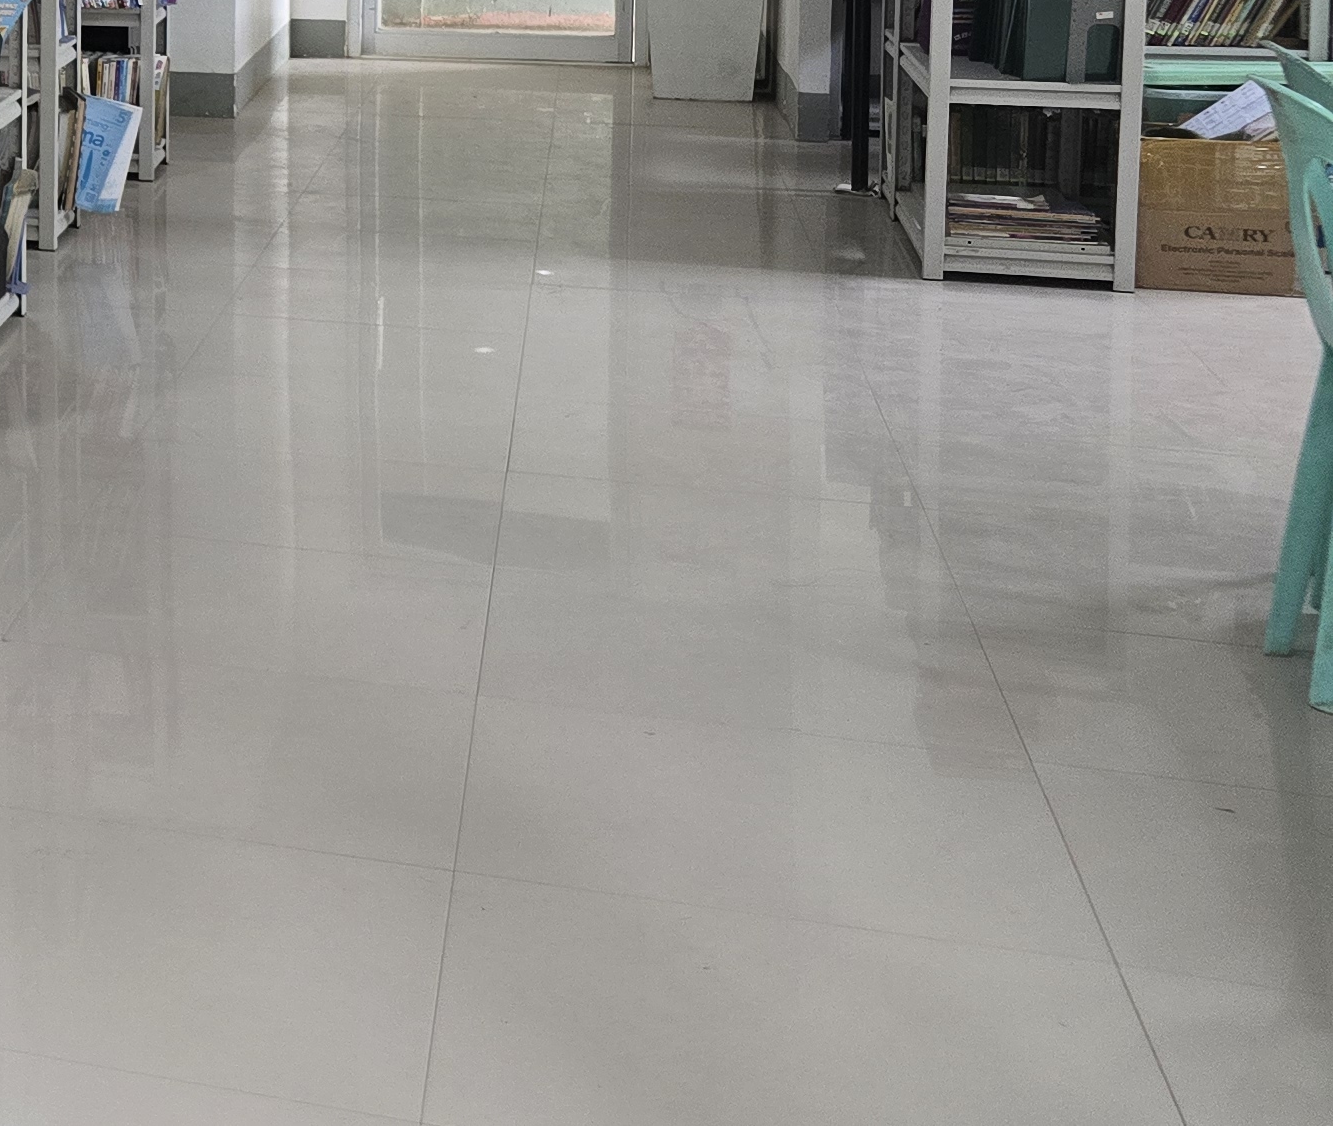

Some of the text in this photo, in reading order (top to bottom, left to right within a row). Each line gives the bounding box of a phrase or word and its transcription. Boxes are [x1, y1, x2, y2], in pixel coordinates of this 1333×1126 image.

[1184, 226, 1276, 242] CARY
[1161, 244, 1214, 254] Electronic
[1217, 246, 1265, 256] Personal
